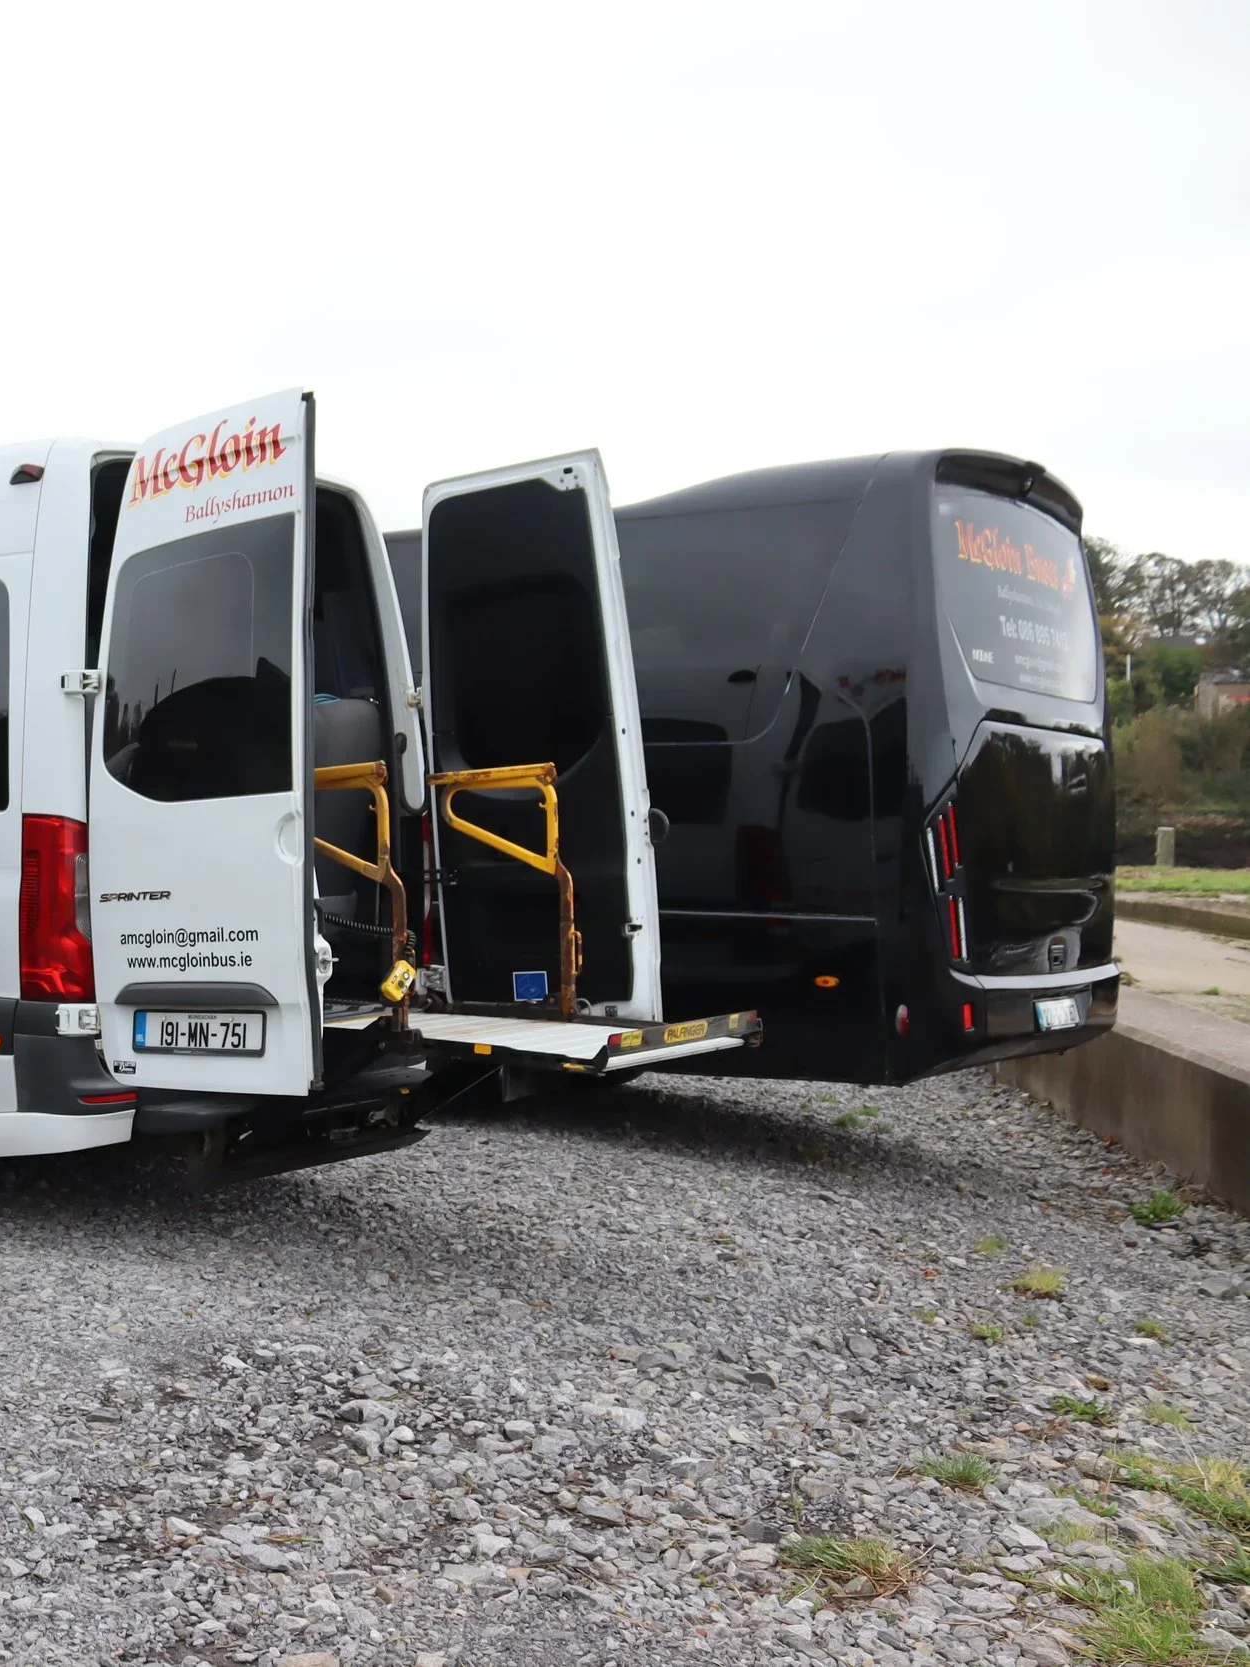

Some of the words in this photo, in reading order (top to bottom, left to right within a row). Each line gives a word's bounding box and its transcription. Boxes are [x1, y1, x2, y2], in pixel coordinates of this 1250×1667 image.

[127, 416, 286, 509] McGloin
[185, 484, 295, 523] Ballyshannon
[99, 890, 171, 903] SPRINTER
[120, 927, 259, 948] amcgloin@gmail.com
[127, 952, 252, 971] www.mcgloinbus.ie
[160, 1021, 246, 1048] 191-MN-751
